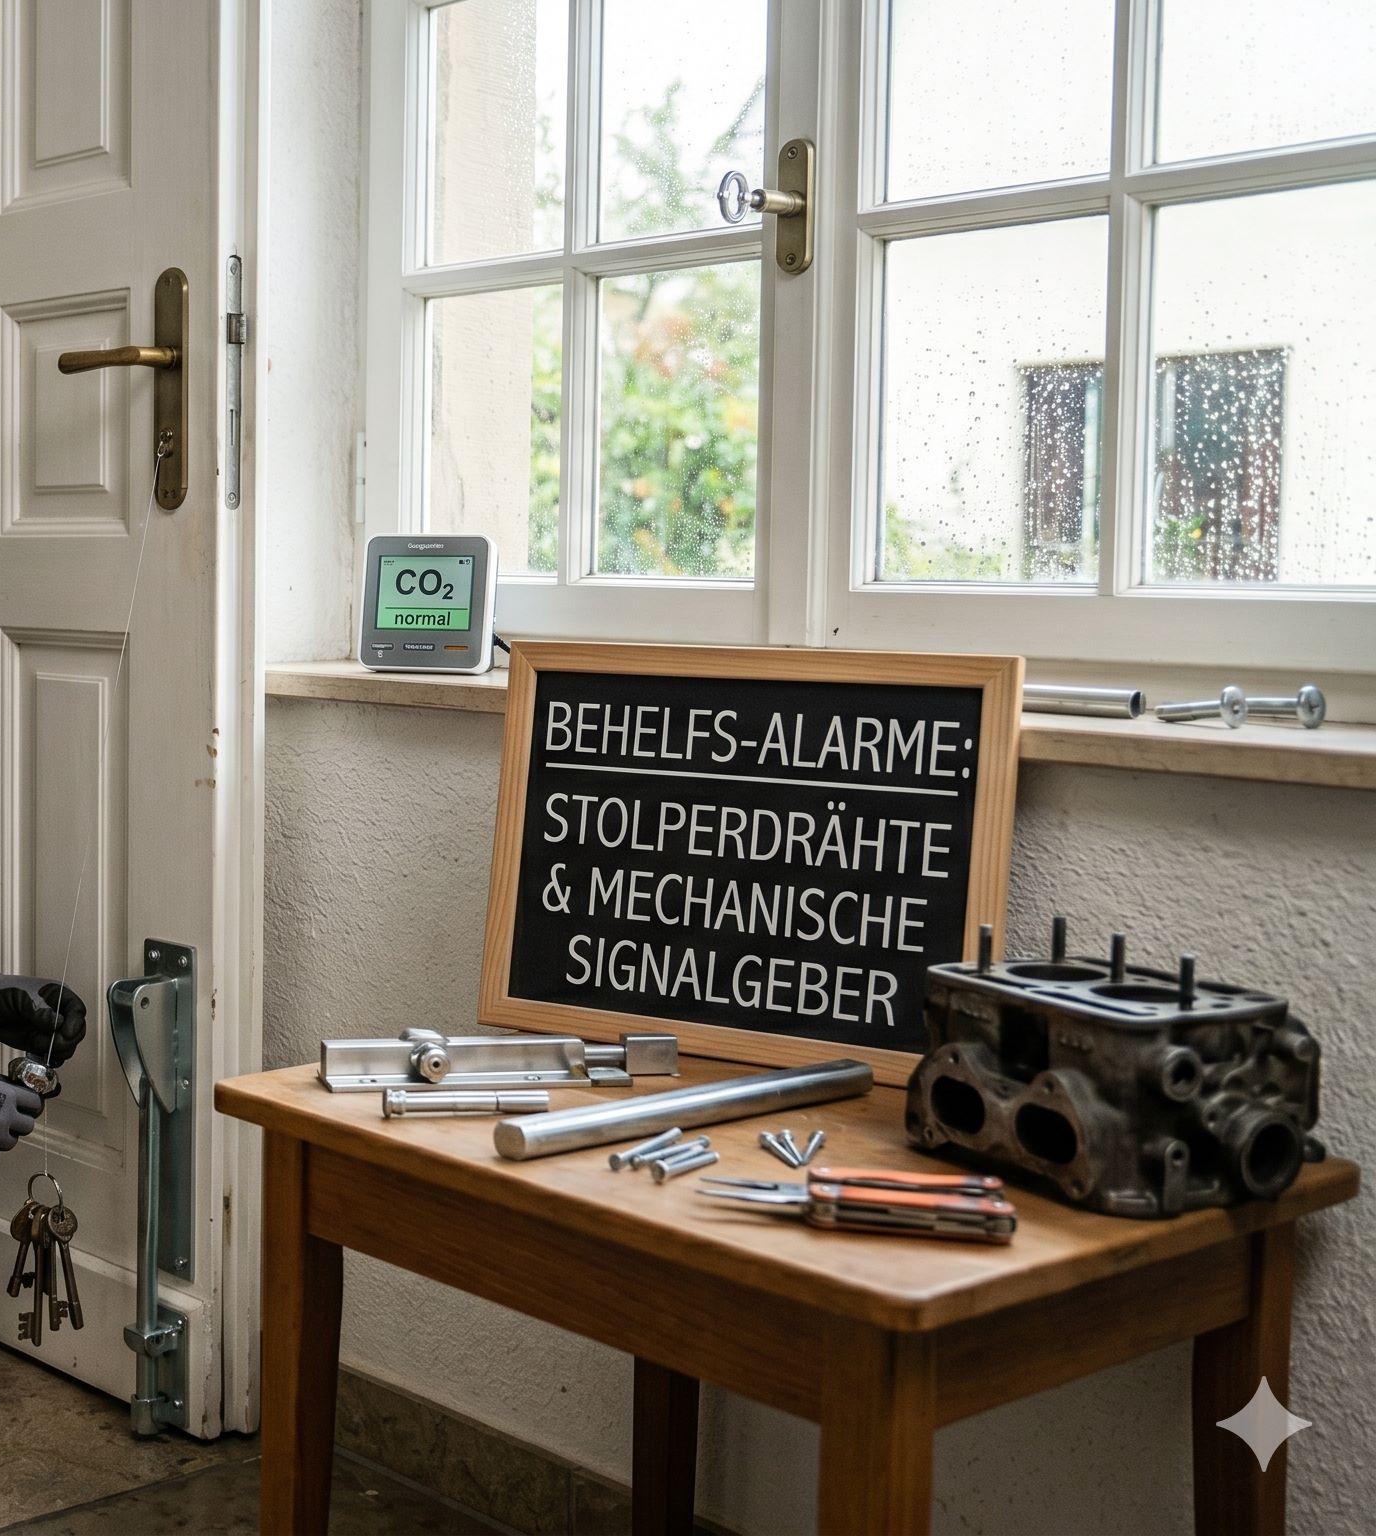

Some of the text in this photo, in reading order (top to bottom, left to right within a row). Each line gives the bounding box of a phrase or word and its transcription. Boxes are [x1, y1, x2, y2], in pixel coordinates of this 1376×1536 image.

[394, 611, 451, 626] normal
[544, 700, 974, 779] BEHELFS-ALARME:
[542, 791, 954, 879] STOLPERDRÄHTE
[541, 862, 929, 954] & MECHANISCHE
[565, 933, 899, 1028] SIGNALGEBER
